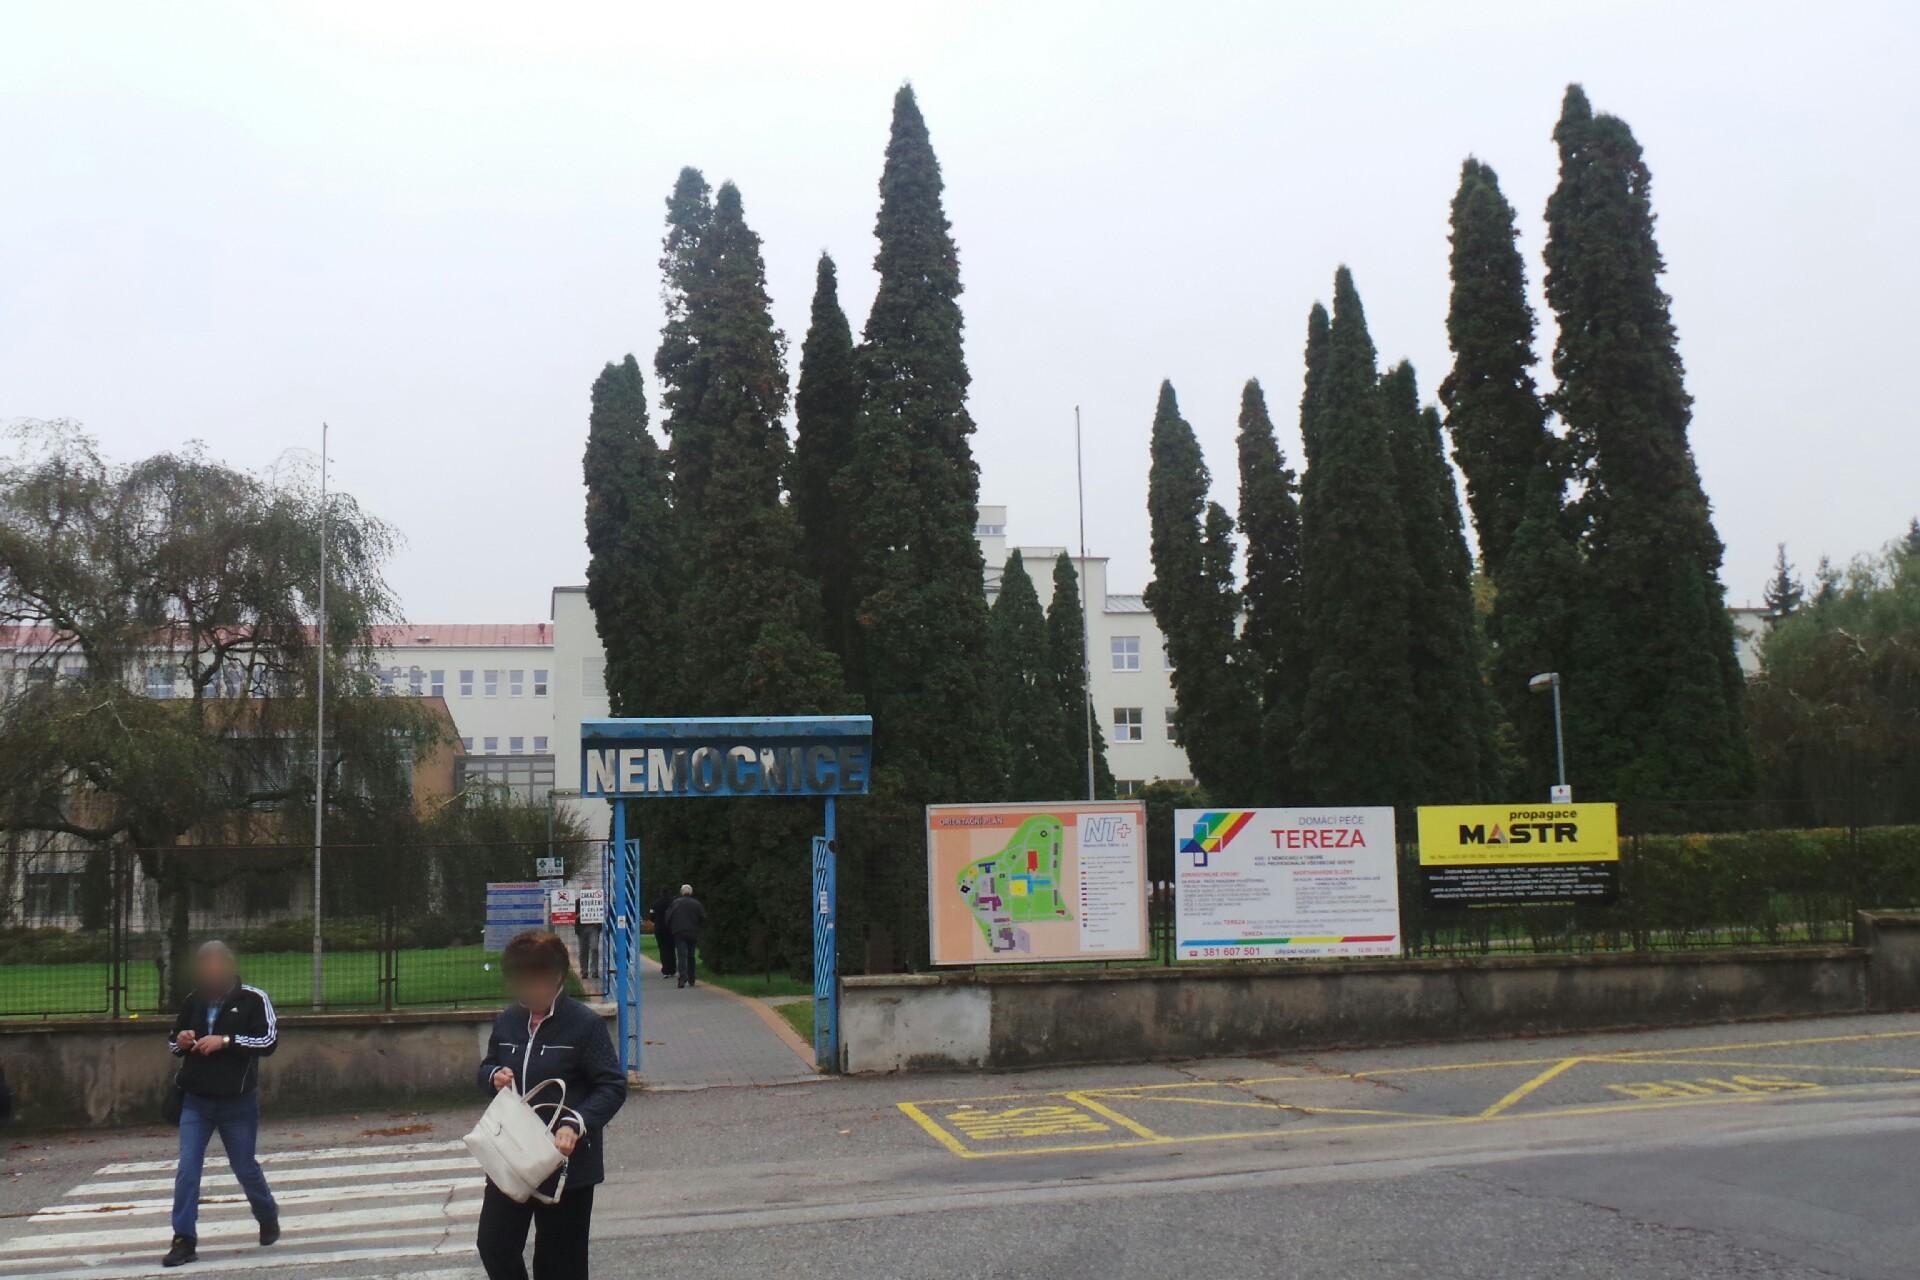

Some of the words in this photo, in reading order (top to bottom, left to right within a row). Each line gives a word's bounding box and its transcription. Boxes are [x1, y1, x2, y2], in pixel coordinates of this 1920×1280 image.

[586, 744, 865, 794] NEMOCNICE
[1509, 809, 1578, 821] propagace
[1271, 829, 1366, 849] TEREZA
[1459, 822, 1578, 845] MASTR
[1203, 948, 1220, 957] 381
[1223, 948, 1241, 956] 607
[1243, 947, 1261, 956] 501
